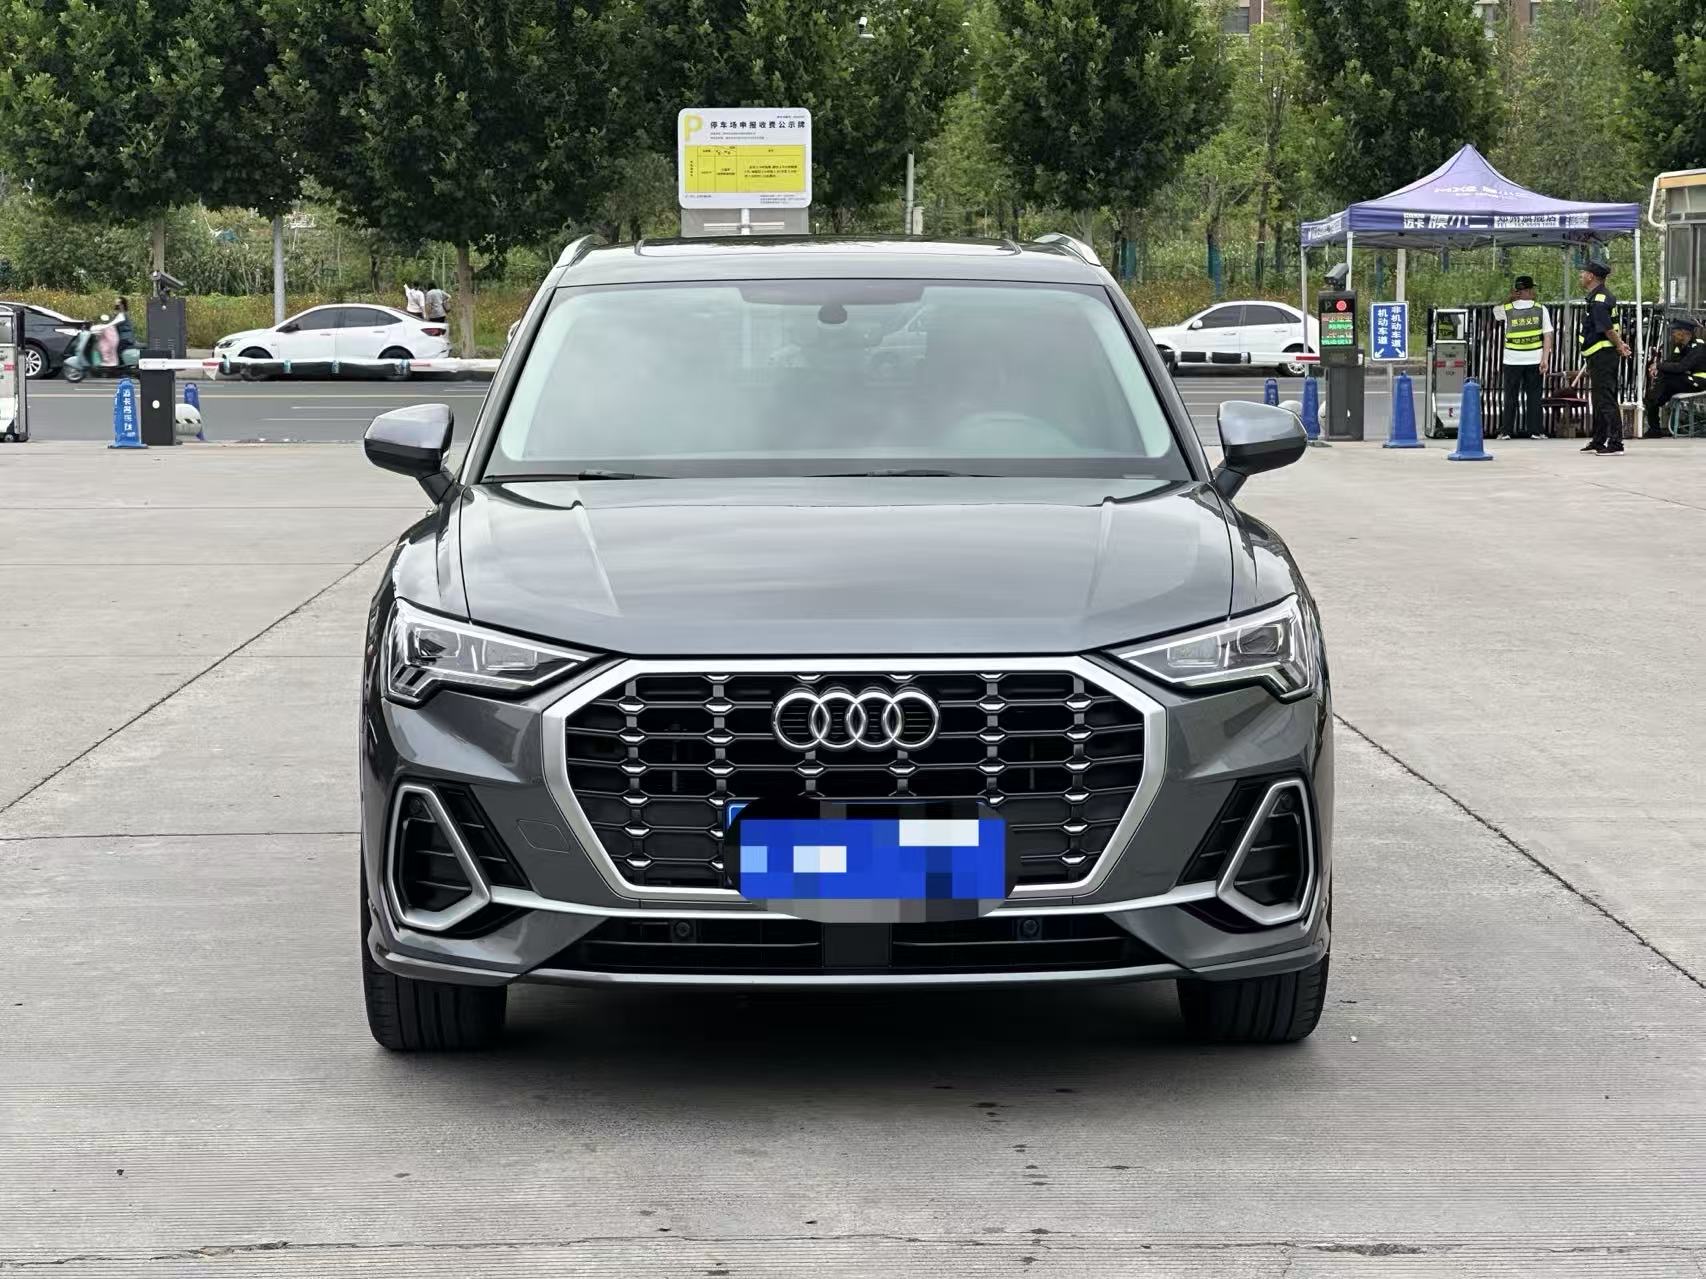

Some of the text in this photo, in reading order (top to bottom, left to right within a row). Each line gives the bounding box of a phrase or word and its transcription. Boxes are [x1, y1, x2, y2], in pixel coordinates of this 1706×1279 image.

[684, 114, 704, 142] P
[710, 121, 806, 129] 停车场申报收费公示牌
[1377, 308, 1389, 345] 机动车道
[1391, 305, 1402, 348] 非机动车道
